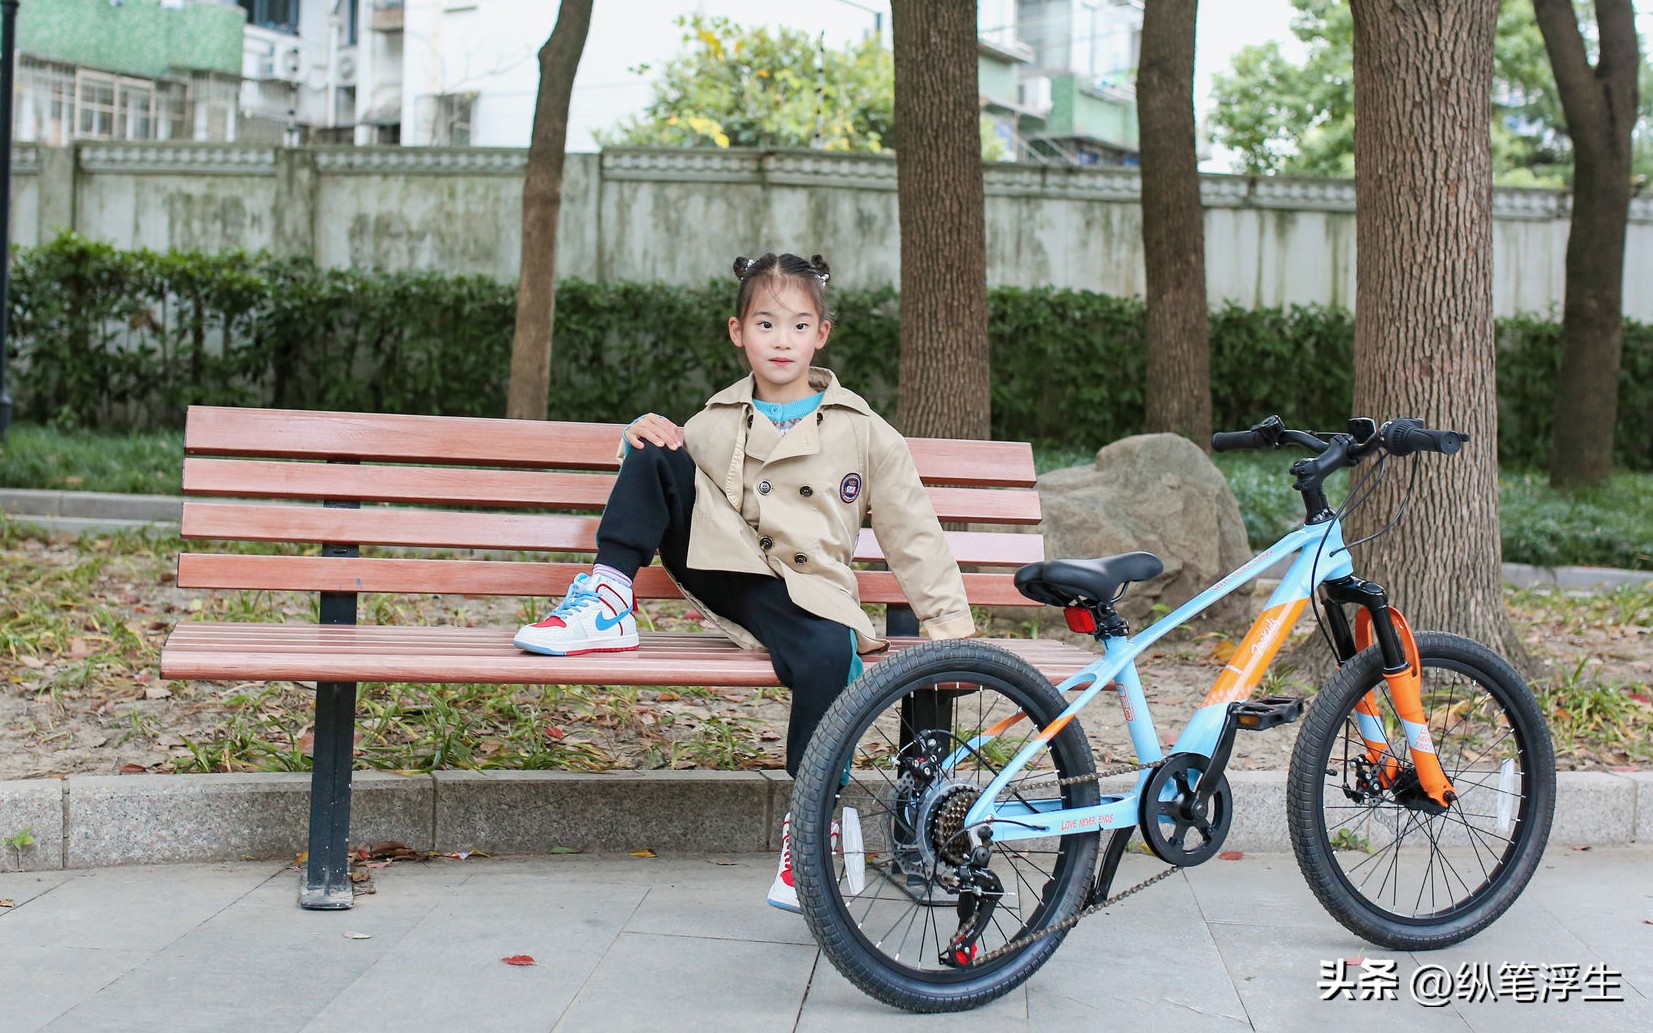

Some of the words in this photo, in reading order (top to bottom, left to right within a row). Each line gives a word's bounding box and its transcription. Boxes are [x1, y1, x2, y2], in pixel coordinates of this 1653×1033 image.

[1061, 820, 1077, 831] LOVE
[1079, 816, 1097, 827] NEVER
[1099, 814, 1114, 825] ENDS
